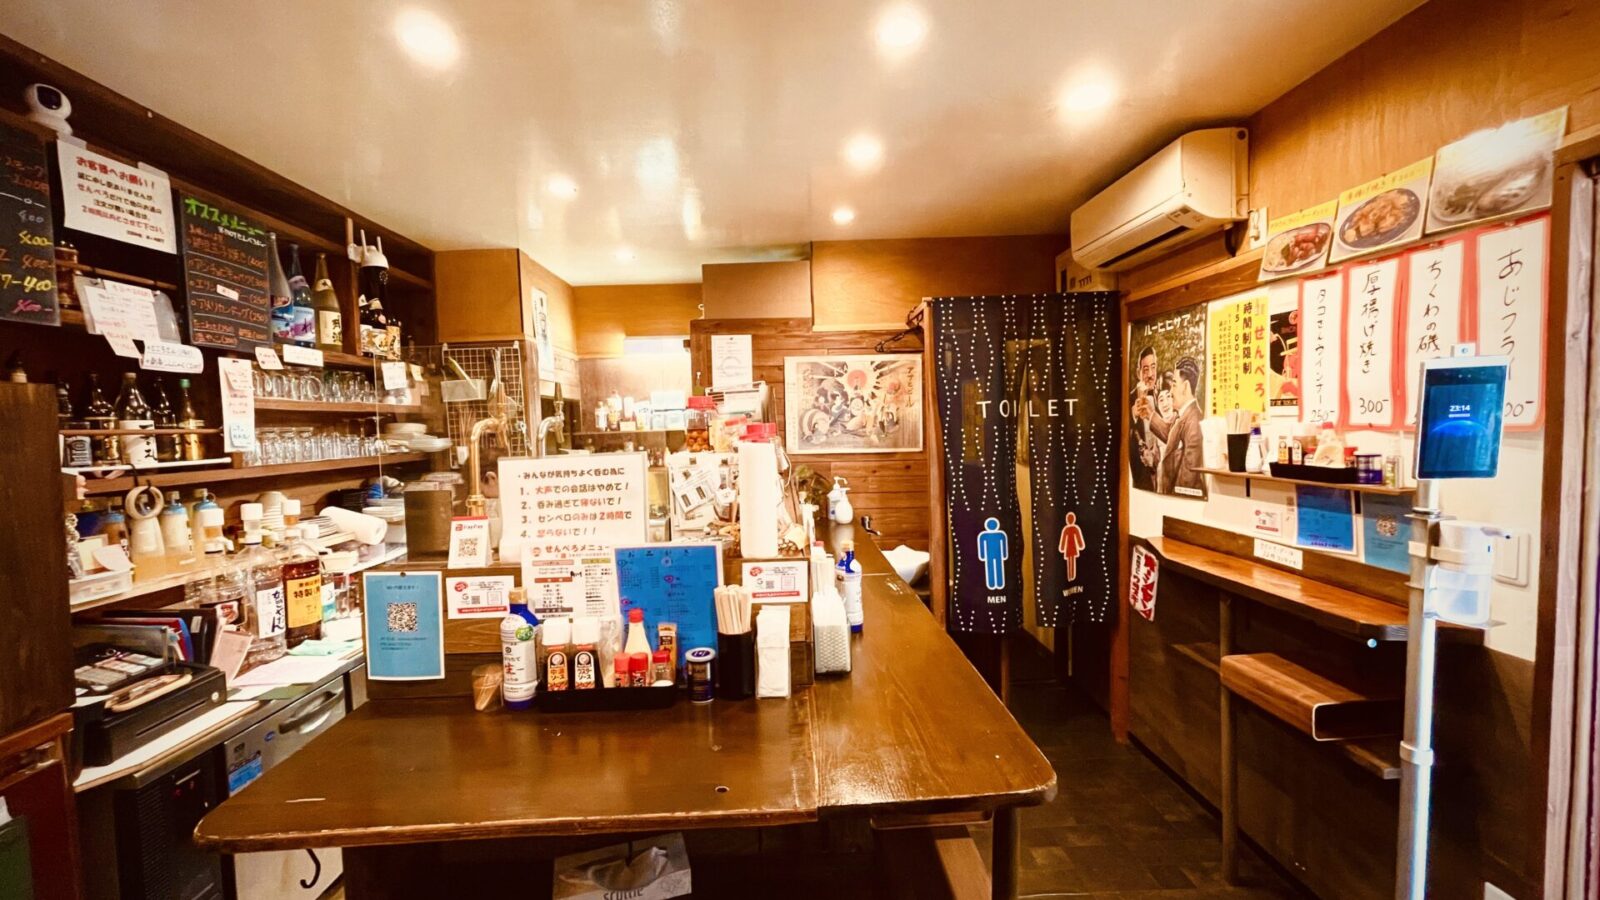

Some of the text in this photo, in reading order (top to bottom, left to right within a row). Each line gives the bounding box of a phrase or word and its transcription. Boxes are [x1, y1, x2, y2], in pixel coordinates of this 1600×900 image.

[1416, 259, 1442, 357] ちくわの磯
[976, 398, 1079, 419] TOILET
[545, 544, 611, 553] せんべろメニュー
[987, 595, 1007, 604] MEN
